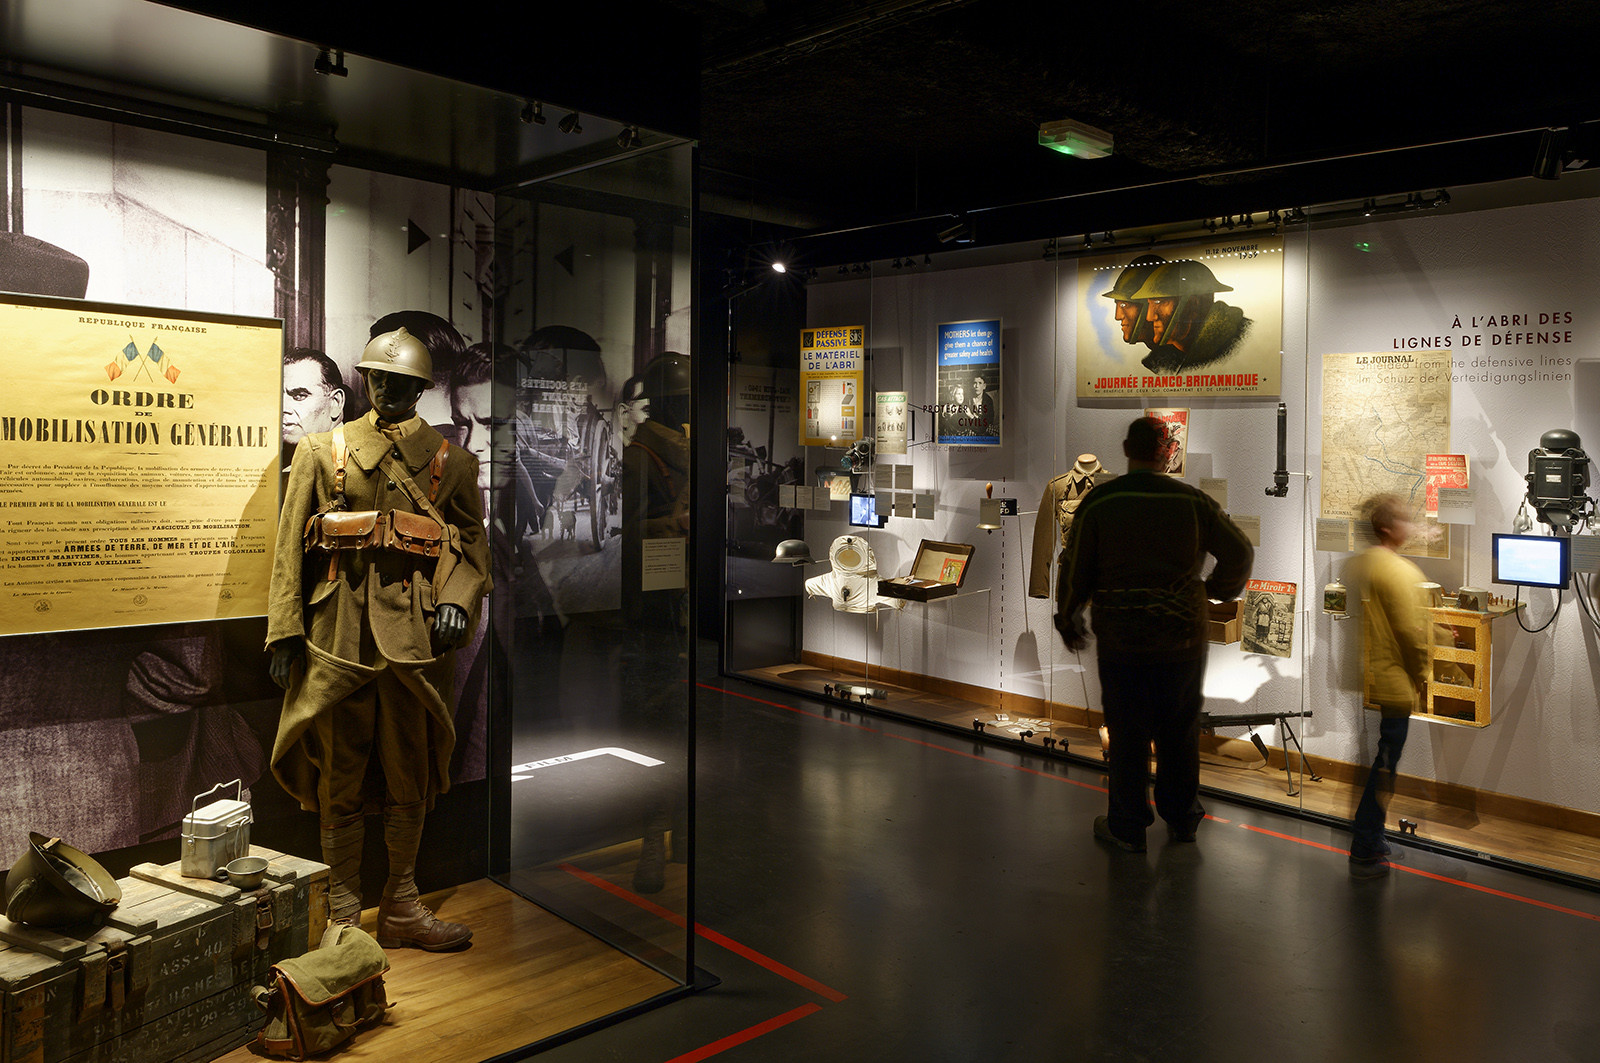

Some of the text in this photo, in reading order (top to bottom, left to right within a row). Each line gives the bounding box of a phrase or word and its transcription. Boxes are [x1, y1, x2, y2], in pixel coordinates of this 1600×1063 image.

[1221, 244, 1259, 253] NOVEMBRE
[1452, 311, 1573, 329] À L'ABRI DES
[151, 323, 207, 334] FRANÇAISE
[816, 328, 847, 339] DÉFENSE
[944, 329, 970, 339] MOTHERS
[977, 329, 987, 337] them
[816, 338, 847, 347] PASSIVE
[944, 342, 954, 351] give
[971, 340, 987, 348] chance
[987, 338, 993, 346] of
[1393, 330, 1572, 349] LIGNES DE DÉFENSE
[803, 350, 860, 360] LE MATÉRIEL
[944, 348, 993, 360] greater safety and health
[1355, 354, 1414, 365] LE JOURNAL
[808, 361, 855, 370] DE L'ABRI
[1415, 358, 1441, 369] from
[1447, 357, 1465, 368] the
[1471, 355, 1534, 368] defensive
[1540, 354, 1572, 366] lines
[1094, 373, 1258, 389] JOURNÉE FRANCO-BRITANNIQUE
[1376, 373, 1415, 384] Schutz
[1420, 372, 1439, 383] der
[1445, 370, 1572, 385] Verteidigungslinien
[90, 388, 195, 409] ORDRE
[922, 402, 988, 414] PROTÉGER LES
[958, 417, 988, 427] CIVILS
[0, 416, 268, 448] MOBILISATION GÉNÉRALE
[63, 544, 101, 553] ARMÉES
[105, 544, 116, 552] DE
[119, 543, 150, 551] TERRE,
[167, 542, 185, 550] MER
[201, 541, 211, 549] DE
[215, 540, 238, 548] L'AIR,
[1248, 580, 1259, 590] Le
[1259, 582, 1285, 592] Miroir
